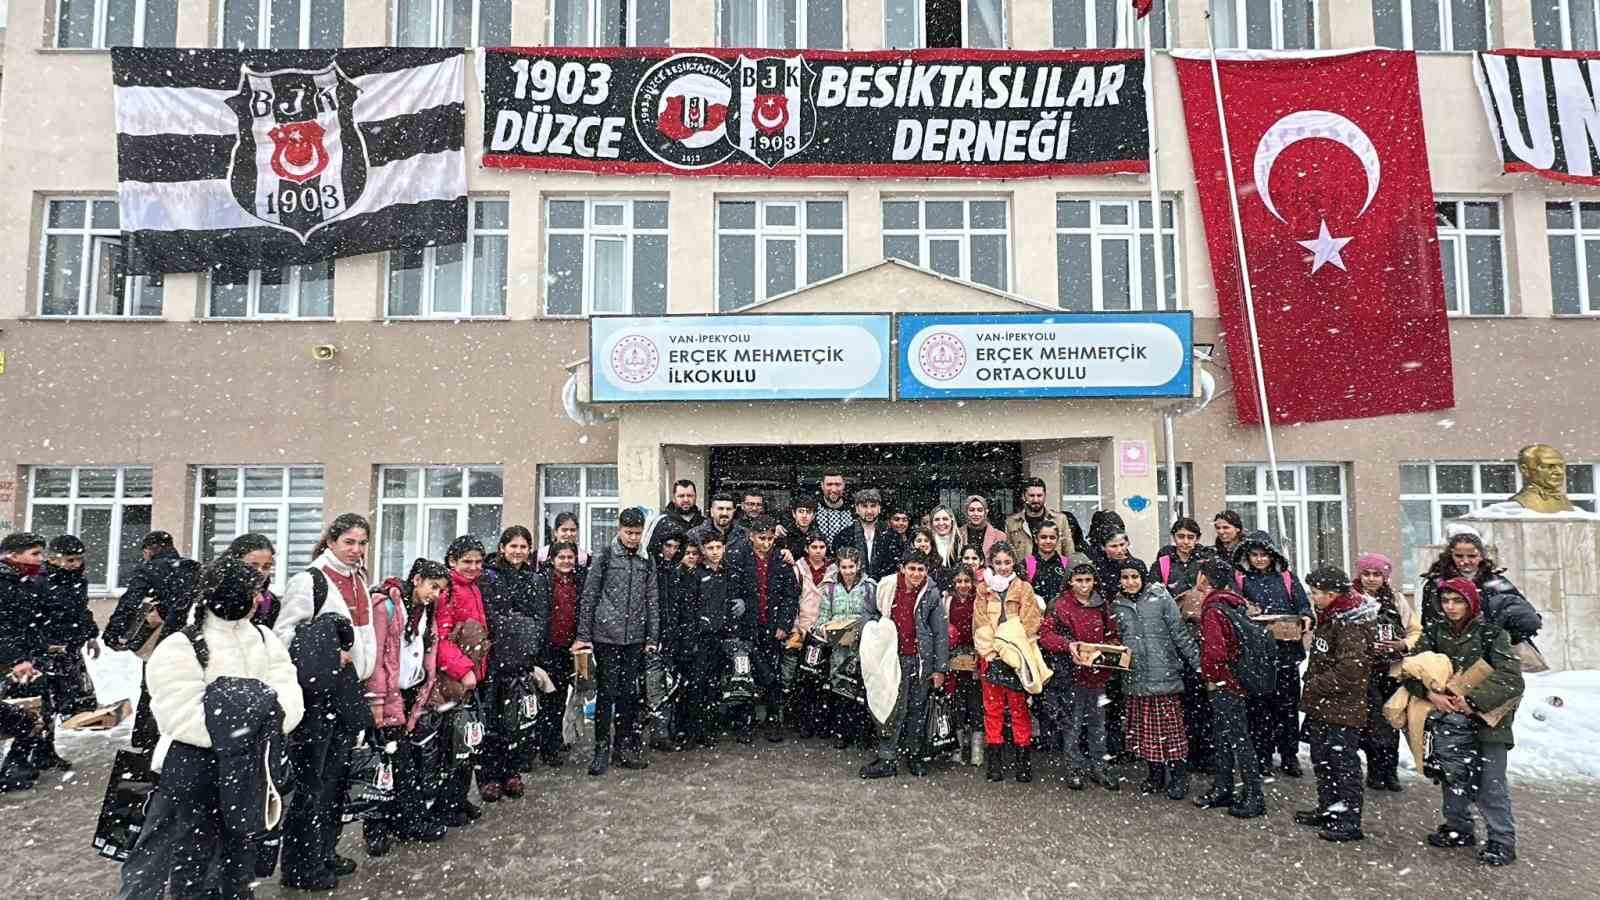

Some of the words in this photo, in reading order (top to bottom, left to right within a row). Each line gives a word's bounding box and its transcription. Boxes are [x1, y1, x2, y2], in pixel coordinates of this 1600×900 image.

[511, 58, 612, 105] 1903
[817, 59, 1126, 108] BESİKTASLILAR
[491, 105, 626, 158] DÜZCE
[892, 111, 1073, 162] DERNEĞİ
[748, 137, 797, 151] 1903
[265, 184, 340, 216] 1903
[669, 333, 751, 344] VAN-İPEKYOLU
[976, 330, 1056, 342] VAN-İPEKYOLU
[669, 349, 728, 366] ERÇEK
[734, 345, 844, 366] MEHMETÇİK
[976, 347, 1034, 364] ERÇEK
[1040, 343, 1148, 362] MEHMETÇİK
[669, 367, 756, 383] İLKOKULU
[976, 366, 1087, 382] ORTAOKULU
